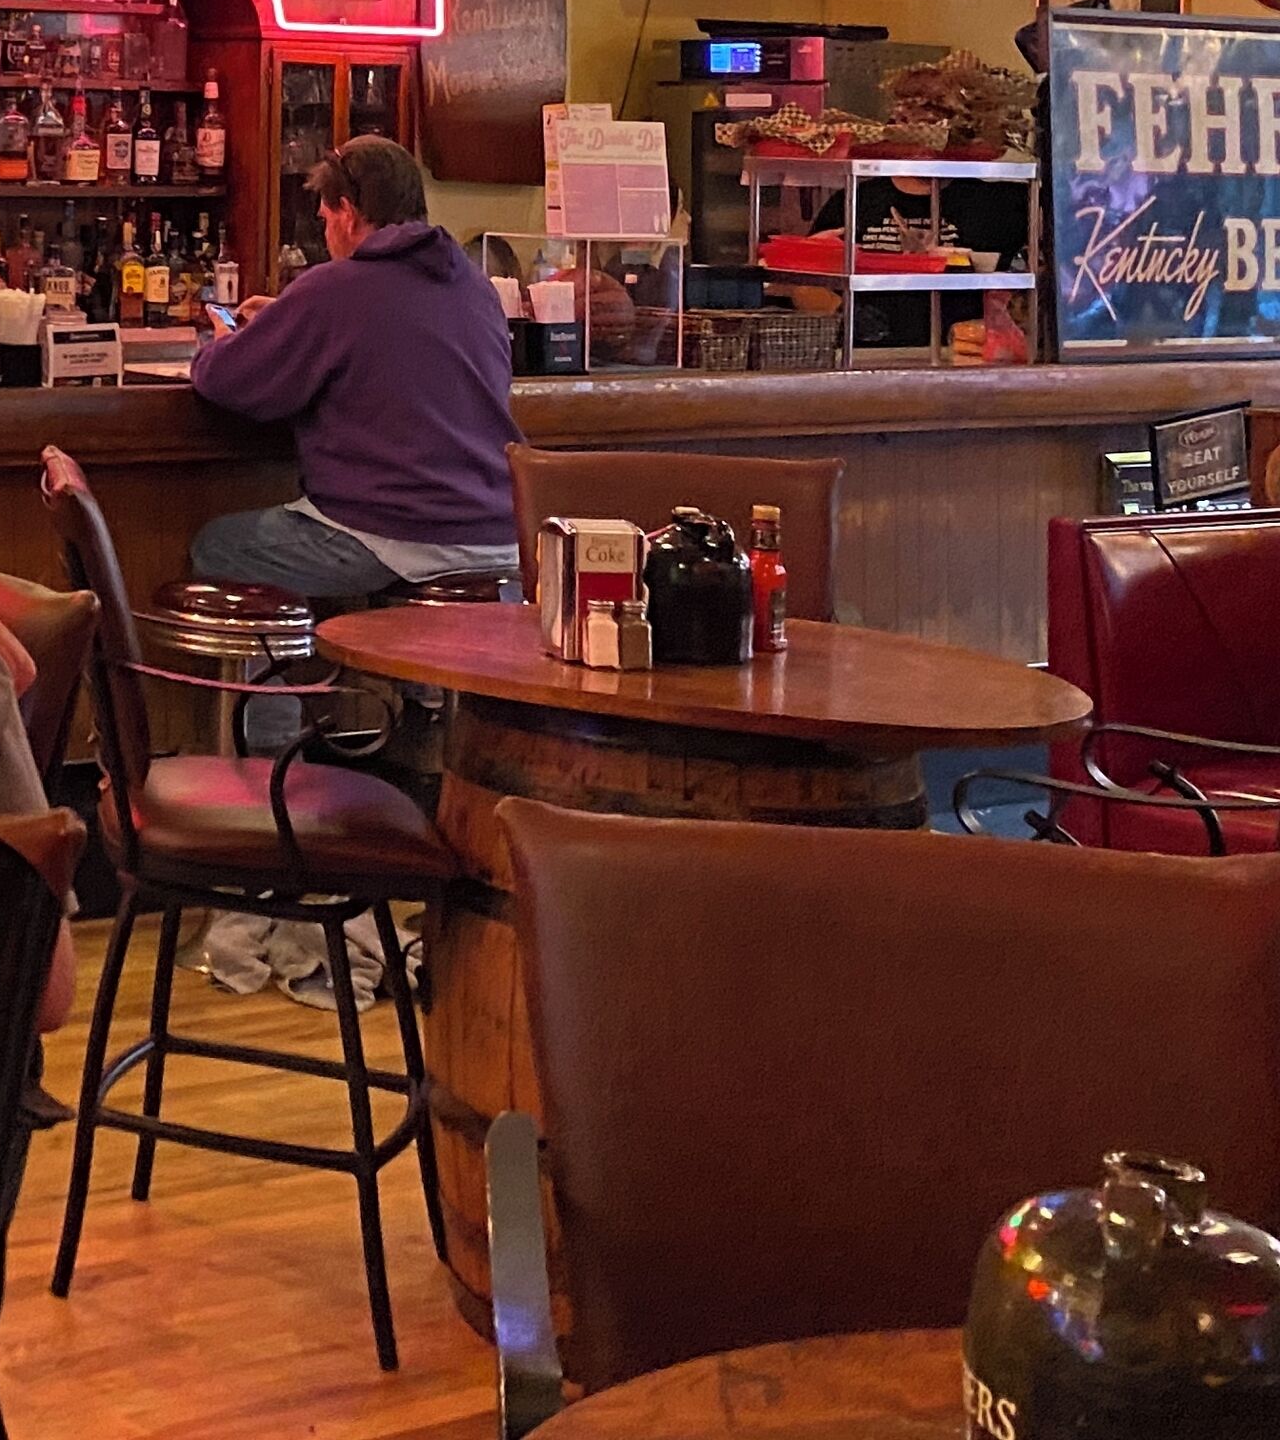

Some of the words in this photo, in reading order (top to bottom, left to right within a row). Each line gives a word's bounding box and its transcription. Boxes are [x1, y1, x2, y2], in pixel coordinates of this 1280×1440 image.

[1071, 194, 1220, 323] Kentucky
[1181, 446, 1222, 468] SEAT
[1167, 465, 1240, 495] YOURSELF
[585, 546, 626, 564] Coke
